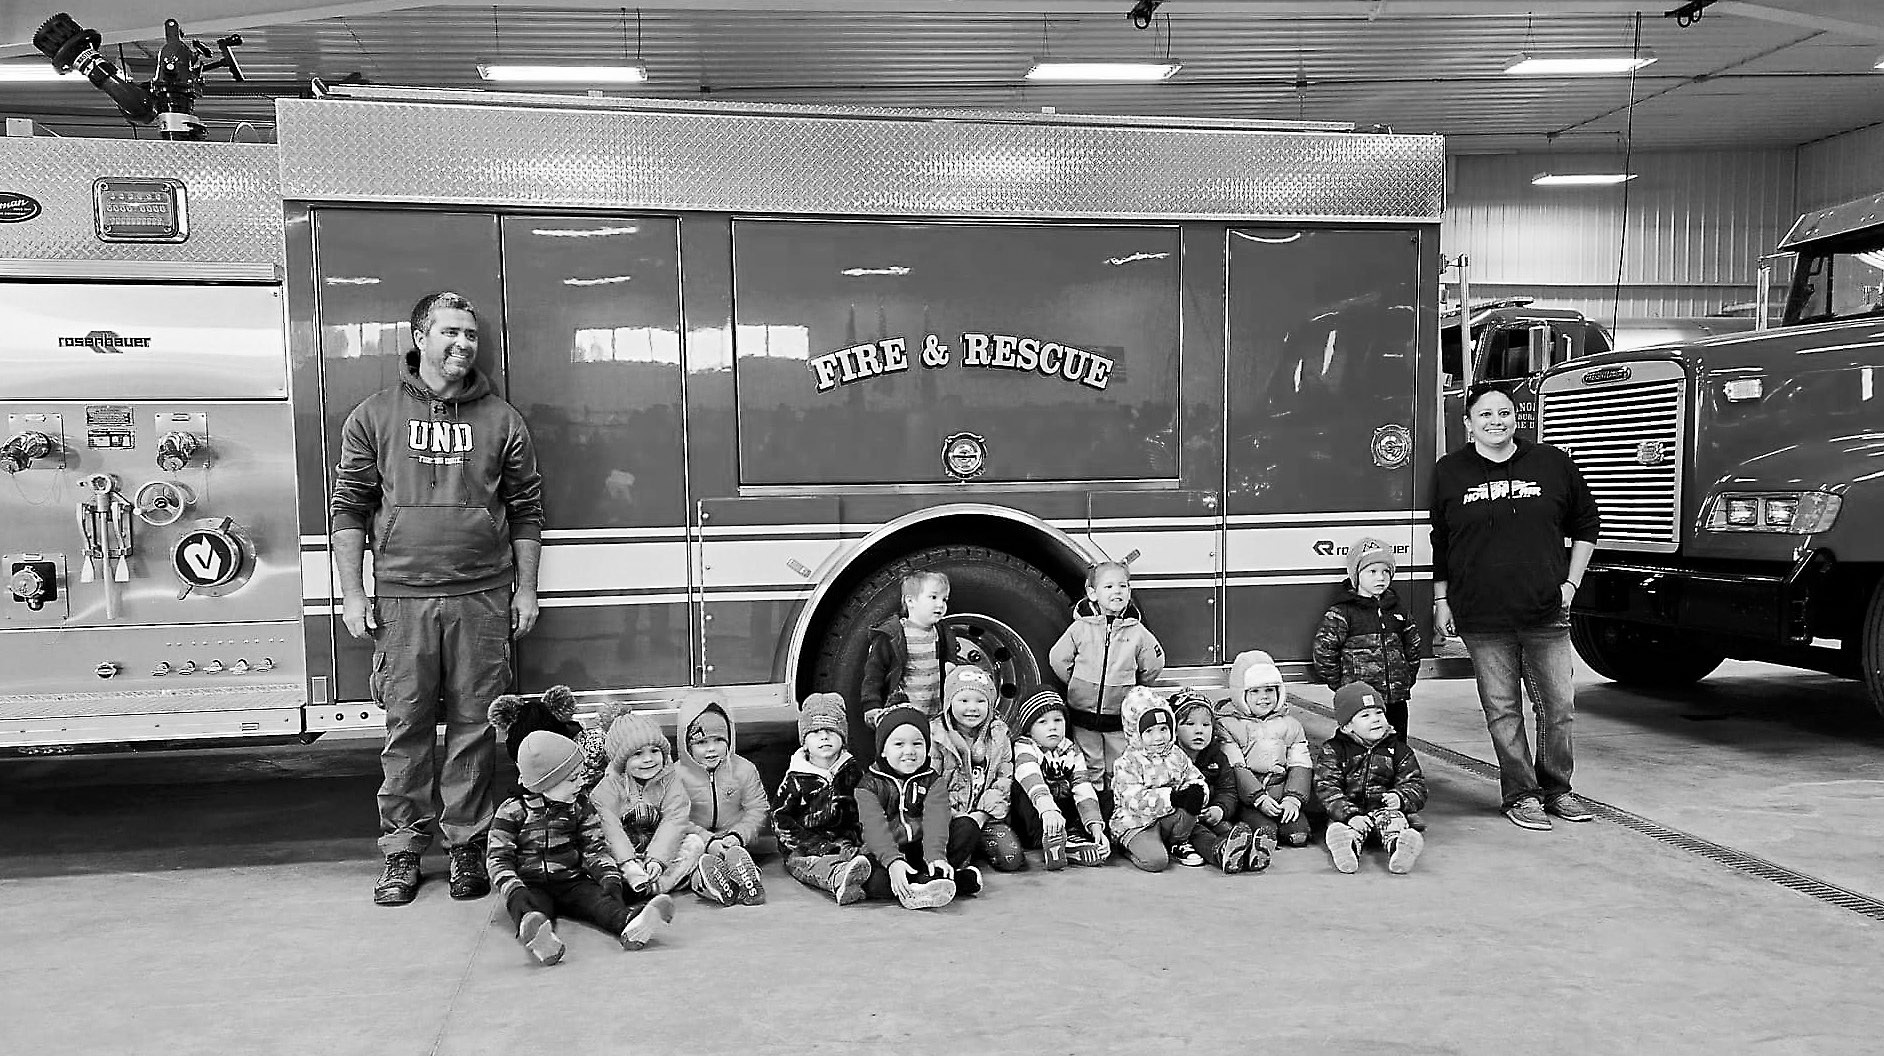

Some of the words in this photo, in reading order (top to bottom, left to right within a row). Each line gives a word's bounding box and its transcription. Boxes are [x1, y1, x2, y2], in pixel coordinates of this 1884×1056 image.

[59, 333, 151, 347] rosenbauer
[810, 337, 908, 392] FIRE
[921, 334, 950, 368] &
[963, 332, 1114, 390] RESCUE
[409, 419, 474, 453] UND
[736, 859, 758, 897] SOREL
